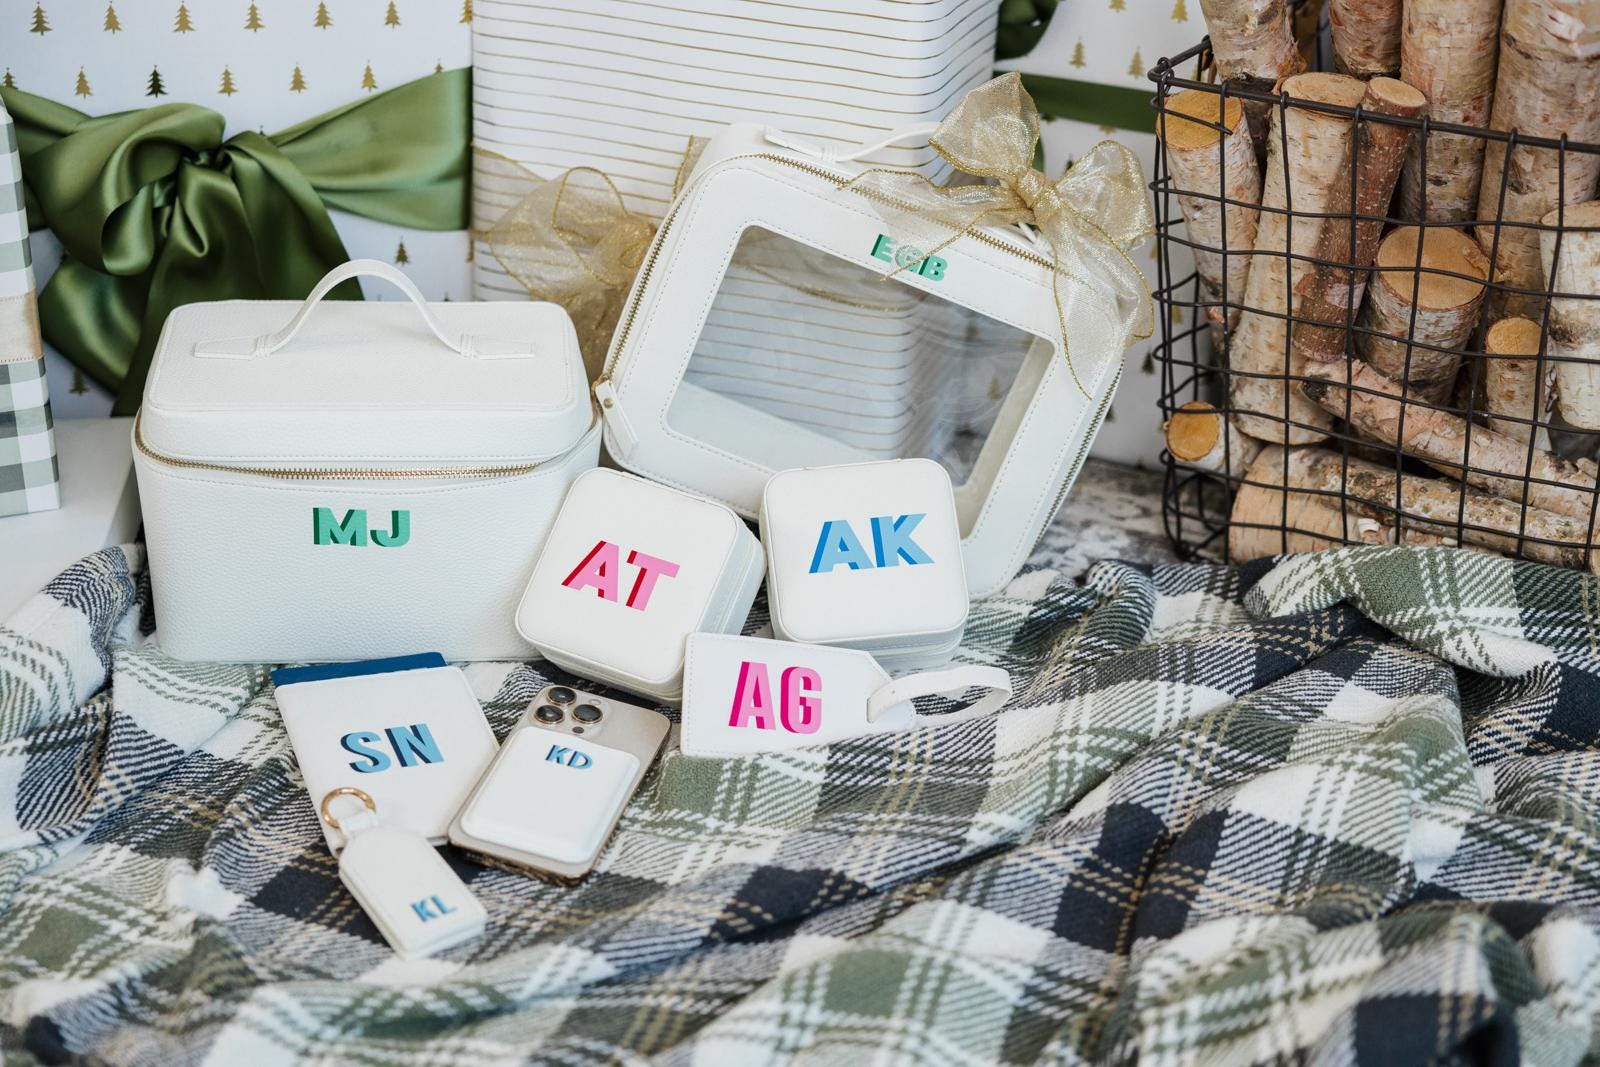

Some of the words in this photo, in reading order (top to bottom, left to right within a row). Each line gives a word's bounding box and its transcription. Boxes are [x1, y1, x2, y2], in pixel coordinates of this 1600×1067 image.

[312, 507, 411, 547] MJ
[809, 513, 934, 574] AK
[562, 540, 679, 611] AT
[728, 661, 823, 735] AG
[340, 723, 444, 774] SN
[545, 744, 593, 769] KD
[410, 894, 457, 922] KL
